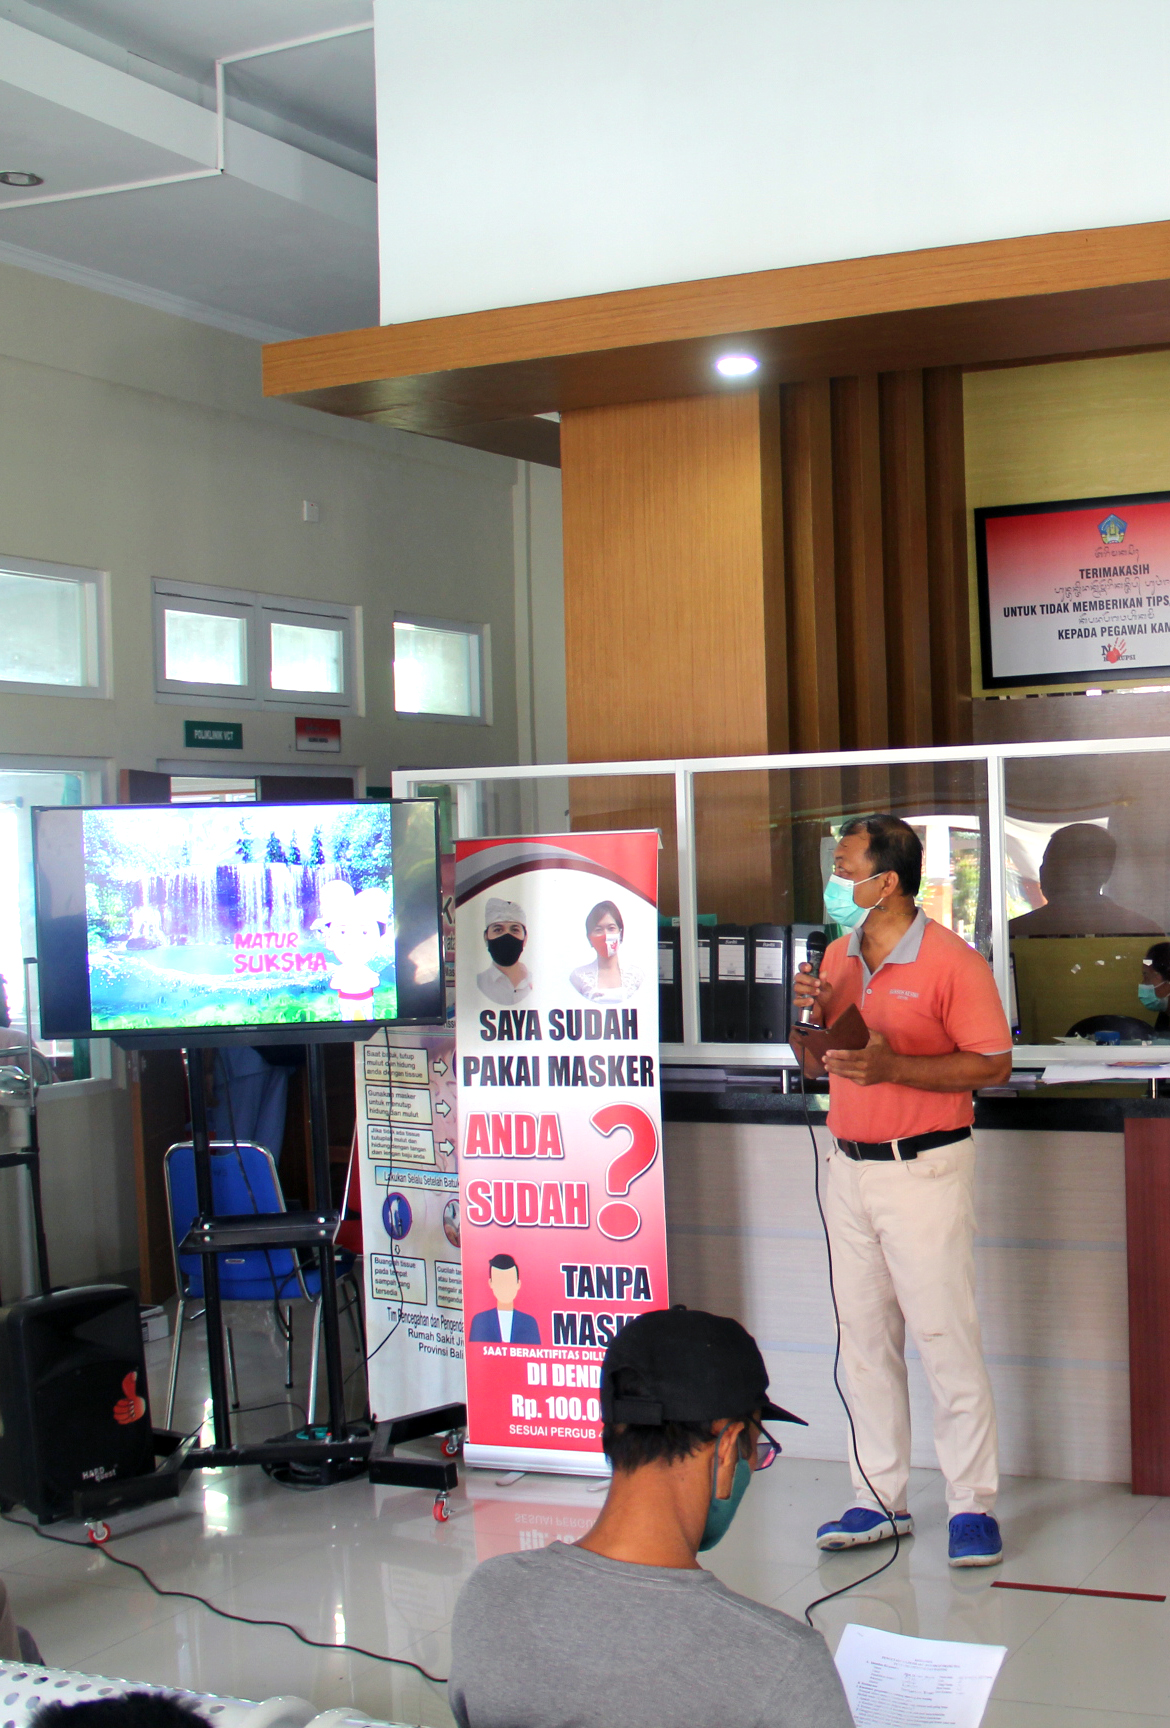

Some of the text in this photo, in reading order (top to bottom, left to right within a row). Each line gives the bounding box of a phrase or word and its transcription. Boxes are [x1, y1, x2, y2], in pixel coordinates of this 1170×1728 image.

[1079, 564, 1150, 579] TERIMAKASIH
[1003, 605, 1037, 618] UNTUK
[1040, 602, 1070, 615] TIDAK
[1073, 597, 1143, 612] MEMBERIKAN
[1058, 627, 1097, 640] KEPADA
[1100, 624, 1147, 637] PEGAWAI
[234, 932, 298, 951] MATUR
[233, 952, 328, 974] SUKSMA
[479, 1008, 638, 1041] SAYA SUDAH
[382, 1051, 398, 1059] bauk,
[397, 1062, 415, 1070] hidung
[463, 1055, 655, 1087] PAKAI MASKER
[463, 1111, 564, 1159] ANDA
[384, 1171, 406, 1182] Lakukan
[407, 1173, 422, 1184] Selalu
[423, 1174, 442, 1186] Setelah
[466, 1101, 658, 1240] SUDAH ?
[400, 1260, 416, 1269] tissue
[375, 1278, 397, 1286] sampah
[560, 1263, 653, 1302] TANPA
[375, 1287, 398, 1296] tersedia
[387, 1307, 397, 1321] Tim
[430, 1313, 440, 1328] dan
[408, 1328, 434, 1341] Rumah
[436, 1333, 455, 1345] Sakit
[552, 1310, 641, 1349] MAS
[419, 1342, 463, 1359] Provinsi Bali
[483, 1346, 605, 1361] SAAT BERAKTIFITAS DILU
[527, 1362, 602, 1389] DI DEND
[512, 1394, 602, 1422] Rp. 100.0
[509, 1424, 548, 1436] SESUAI
[550, 1427, 597, 1439] PERGUB
